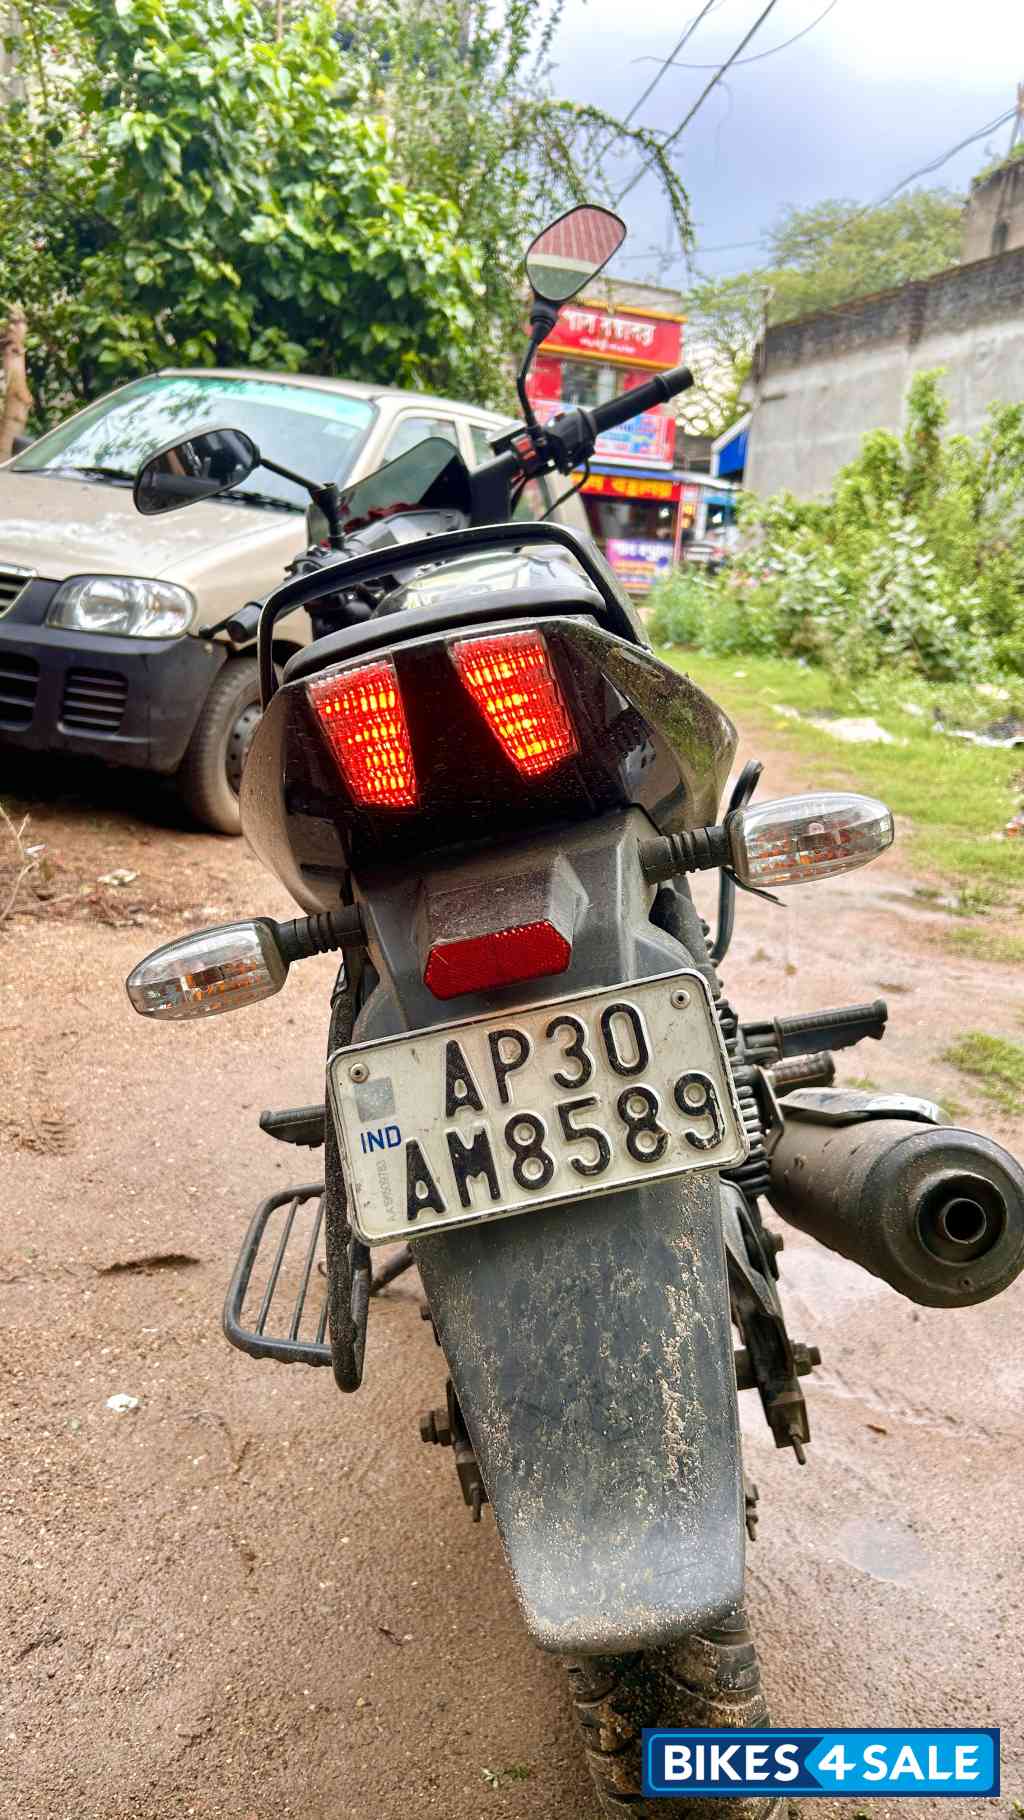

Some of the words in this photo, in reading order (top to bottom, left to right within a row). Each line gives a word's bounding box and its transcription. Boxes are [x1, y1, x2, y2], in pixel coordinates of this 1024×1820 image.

[444, 1002, 650, 1117] AP30
[360, 1125, 402, 1154] IND
[405, 1073, 726, 1221] AM8589
